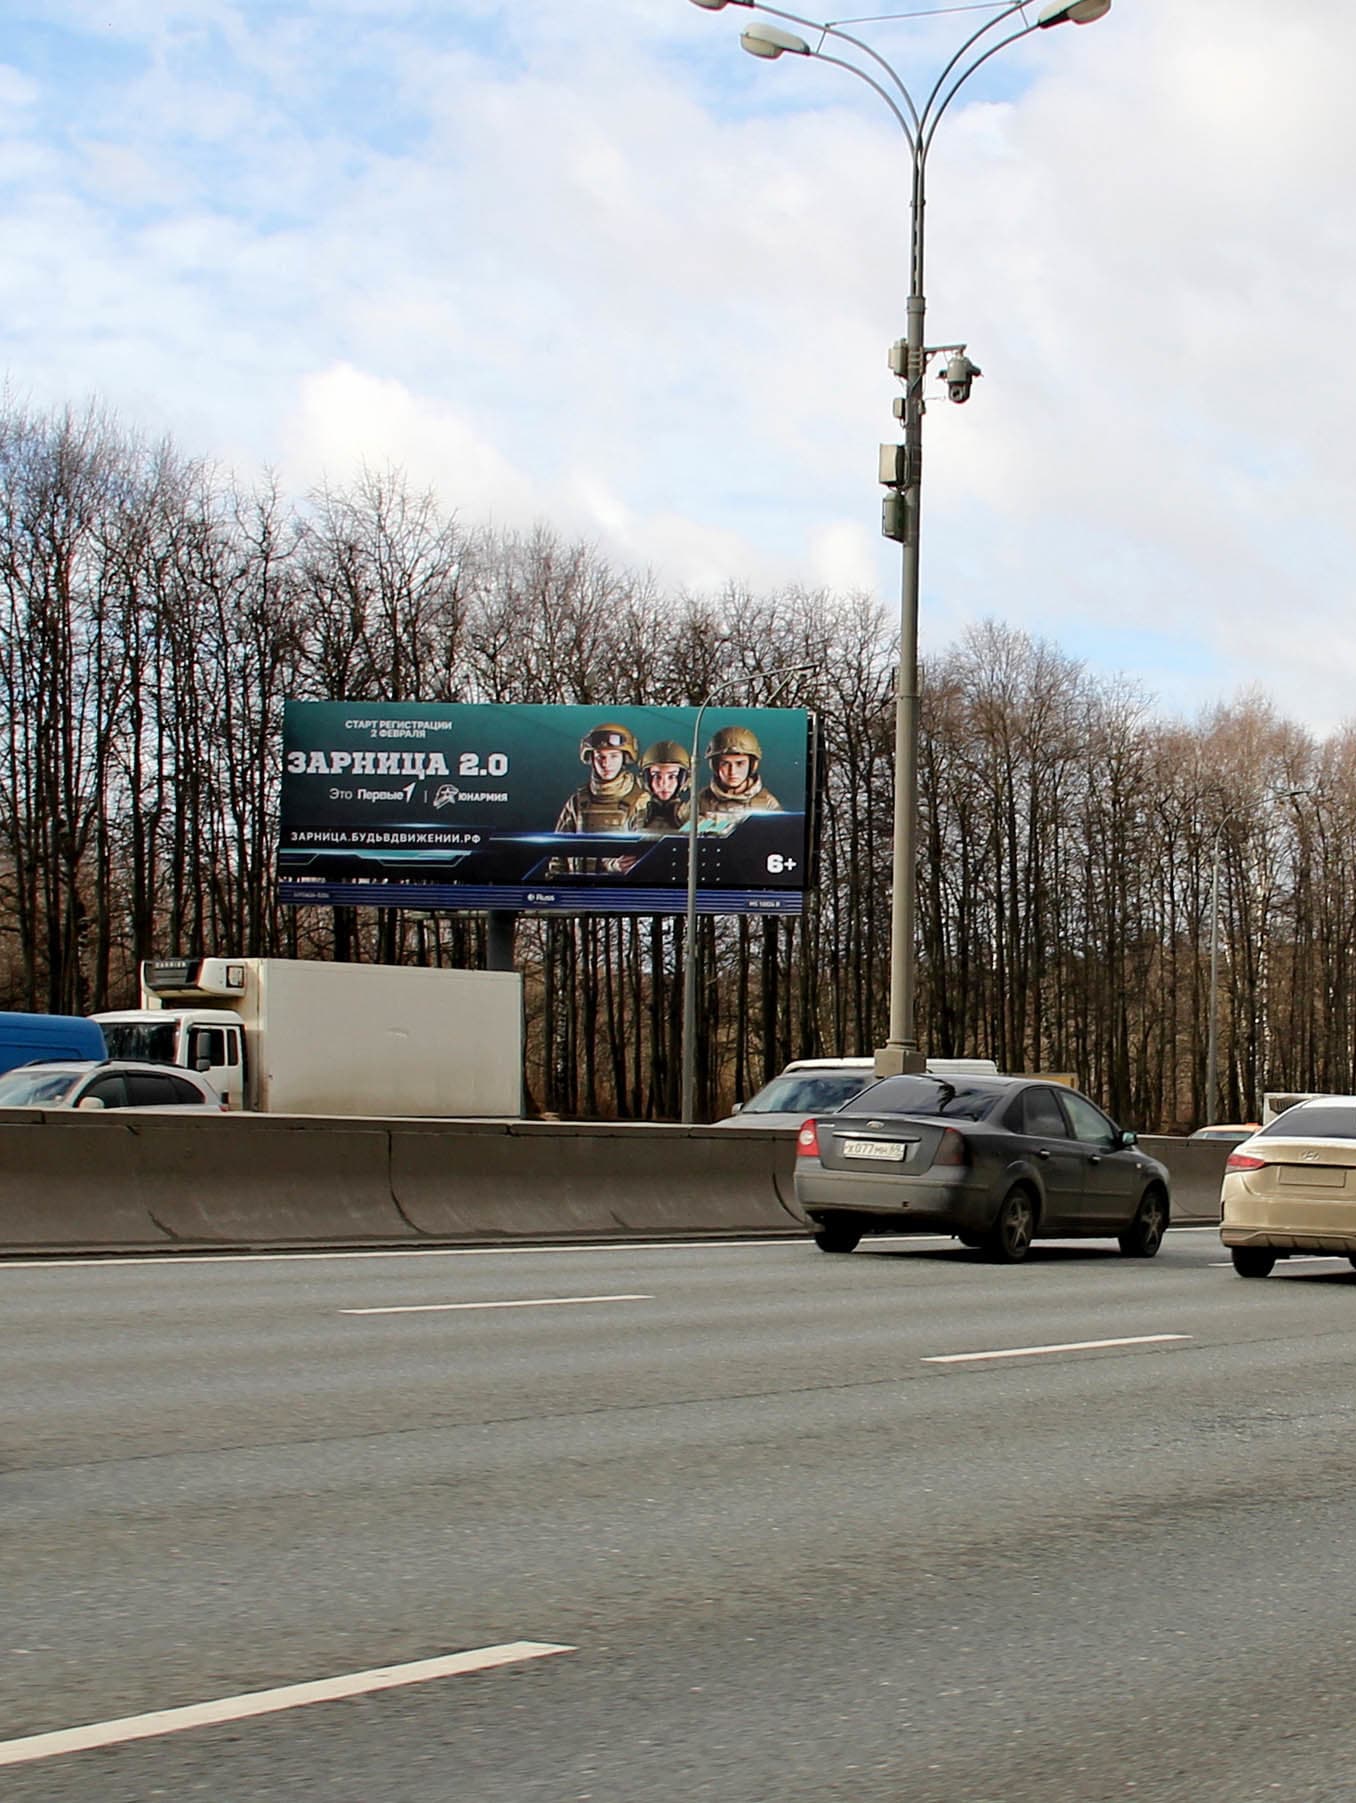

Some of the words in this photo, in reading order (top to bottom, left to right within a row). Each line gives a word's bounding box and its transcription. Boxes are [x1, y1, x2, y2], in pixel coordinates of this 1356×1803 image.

[345, 720, 378, 729] СТАРТ
[379, 720, 453, 731] РЕГИСТРАЦИИ
[370, 729, 377, 738] 2
[379, 729, 426, 738] ФЕВРАЛЯ
[287, 751, 449, 780] ЗАРНИЦА
[458, 752, 508, 776] 2.0
[329, 788, 353, 800] Это
[357, 788, 404, 803] Первые
[458, 792, 508, 802] ЮНАРМИЯ
[290, 832, 481, 844] ЗАРНИЦА.БУДЬВДВИЖЕНИИ.РФ
[766, 854, 797, 874] 6+
